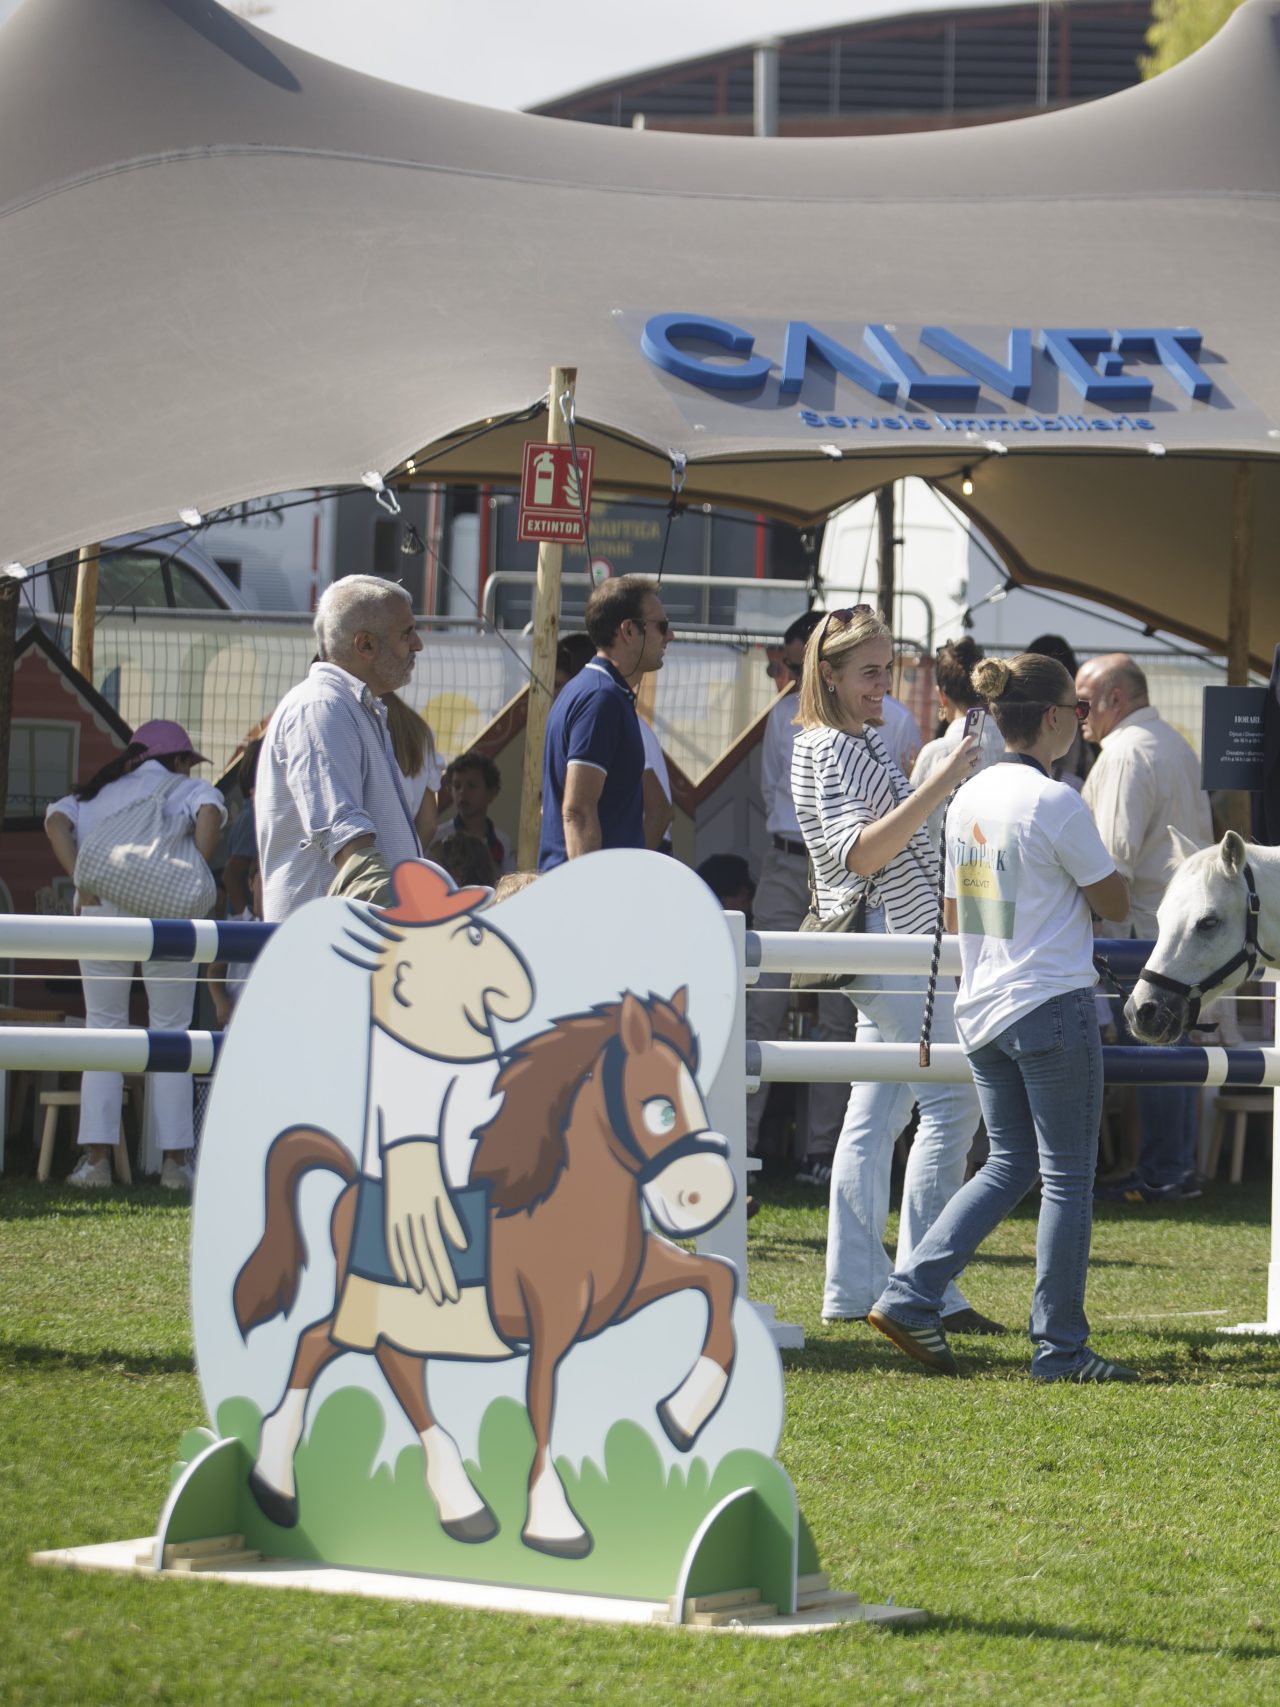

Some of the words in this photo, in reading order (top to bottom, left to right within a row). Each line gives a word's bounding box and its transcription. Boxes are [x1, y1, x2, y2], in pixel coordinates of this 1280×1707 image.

[641, 313, 1212, 401] CALVET
[800, 410, 931, 430] Serveis
[935, 414, 1155, 432] Immobiliaris
[527, 520, 580, 534] EXTINTOR
[963, 878, 990, 888] CALVET
